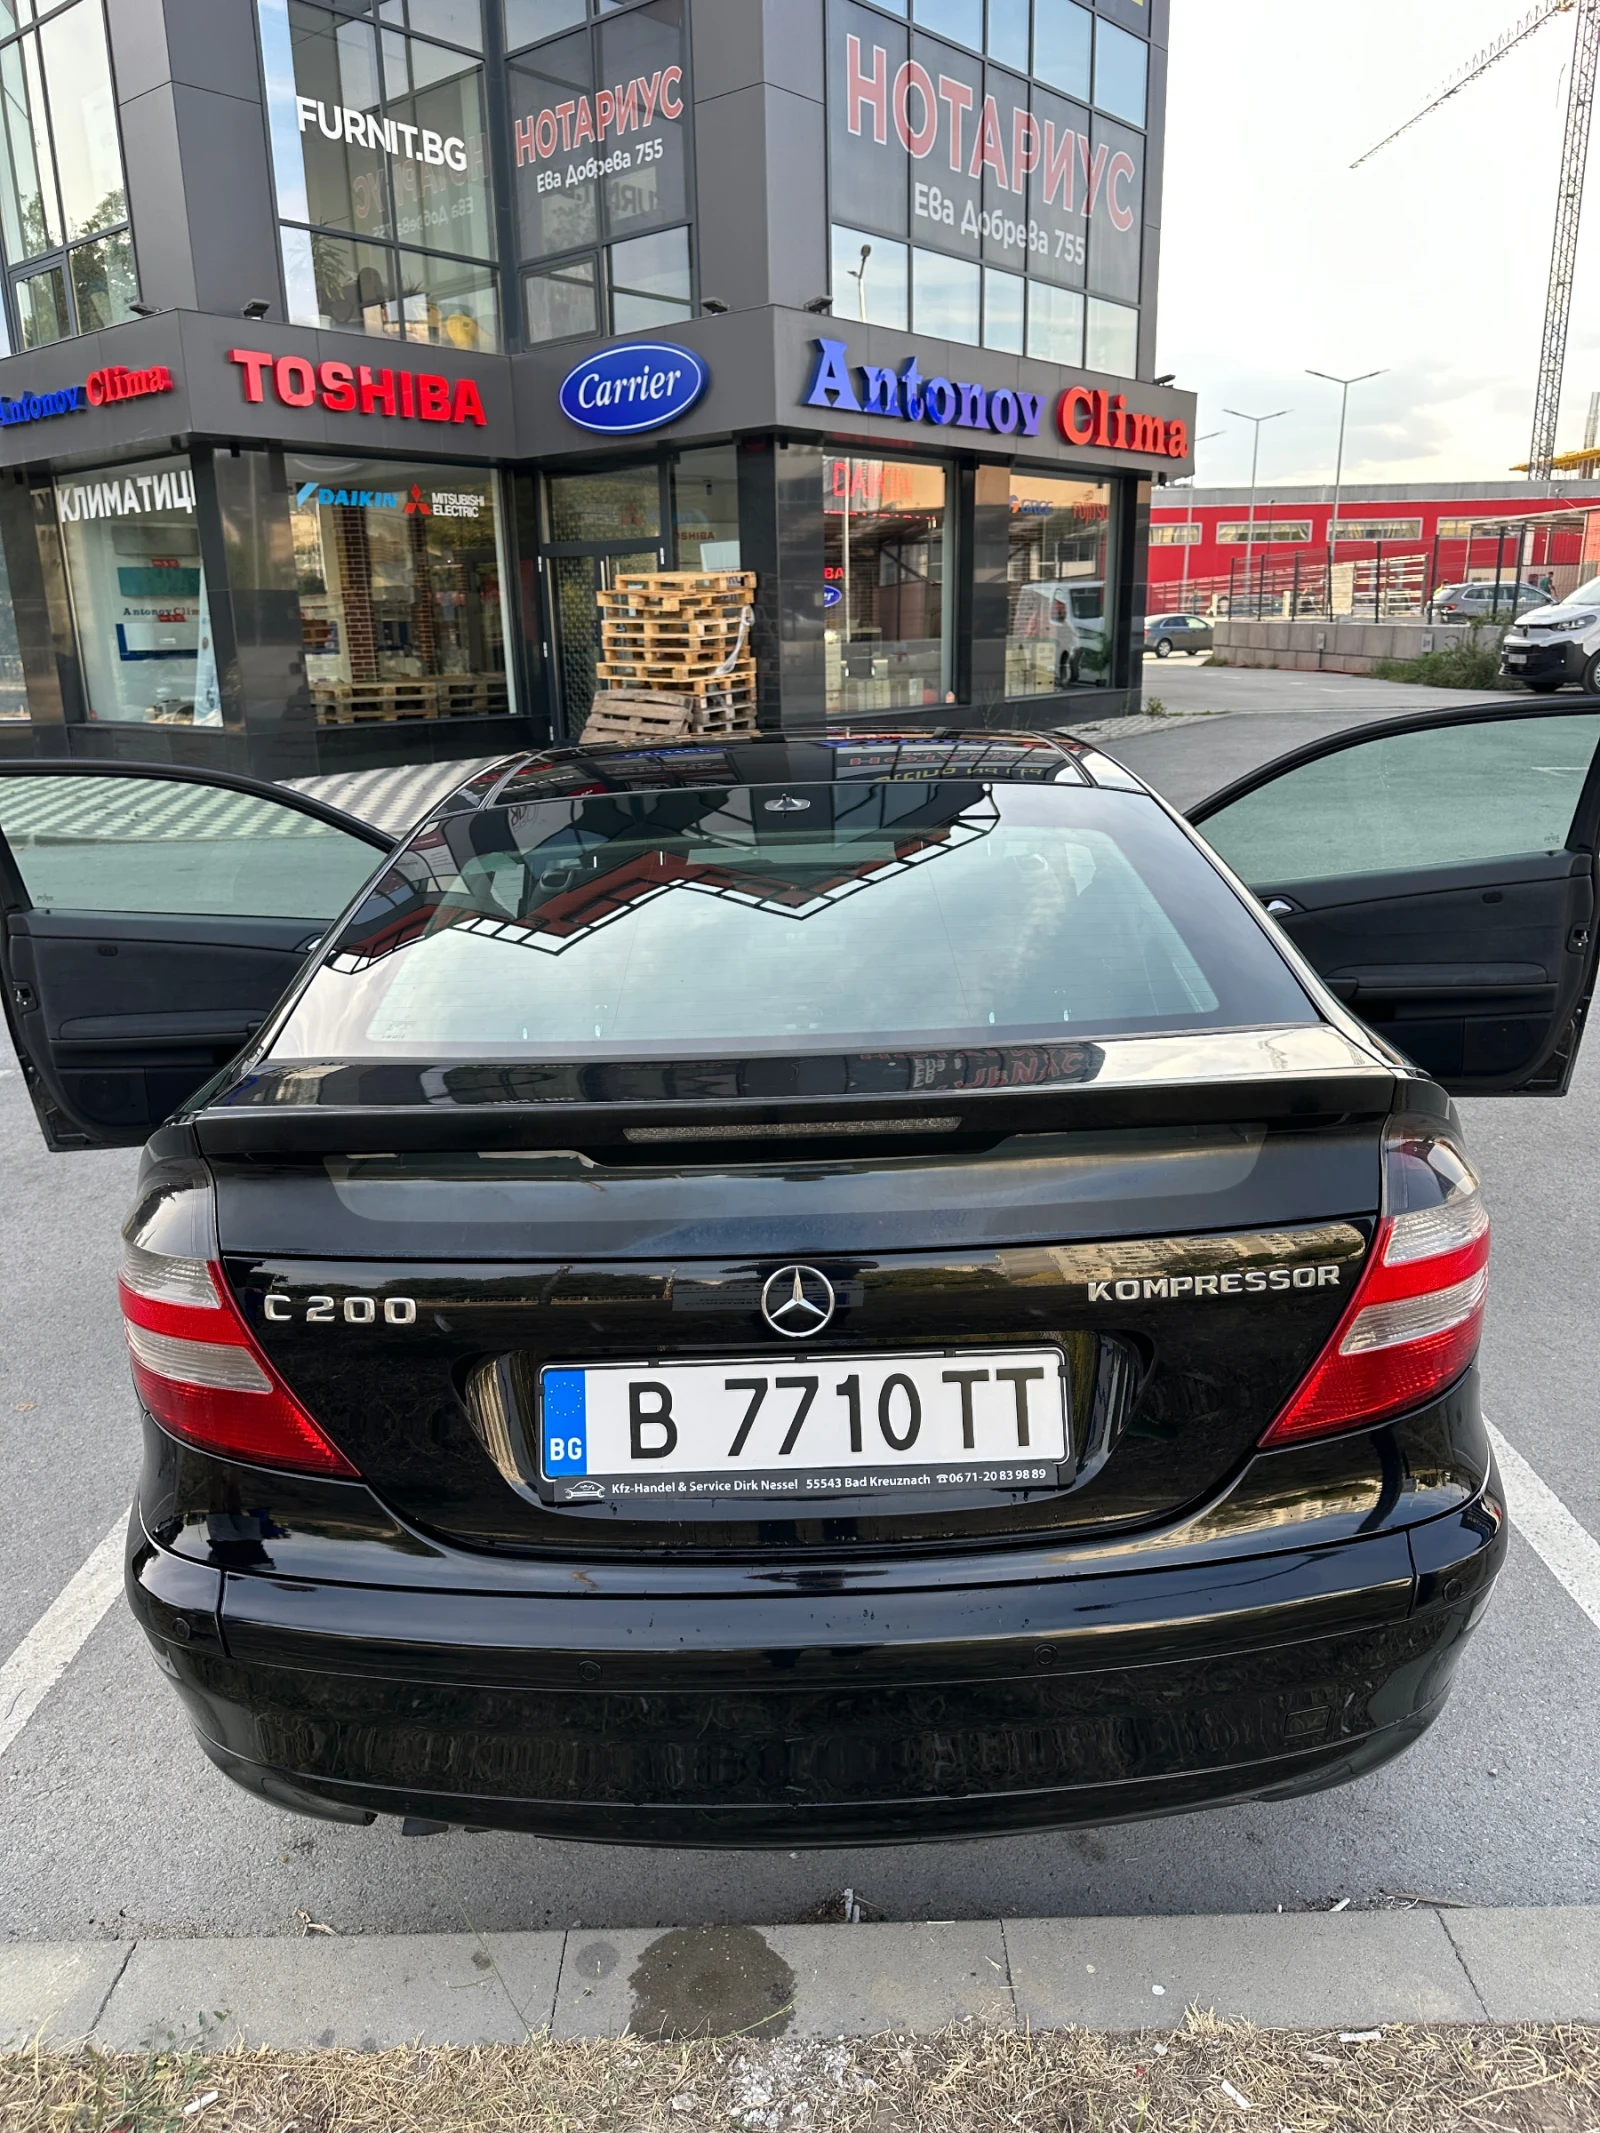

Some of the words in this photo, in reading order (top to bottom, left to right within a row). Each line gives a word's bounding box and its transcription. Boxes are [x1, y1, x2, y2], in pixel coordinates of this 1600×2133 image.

[296, 95, 468, 172] FURNIT.BG
[515, 65, 684, 168] НОТАРИУС
[847, 33, 1136, 232] НОТАРИУС
[536, 170, 562, 193] Ева
[565, 150, 632, 188] Добрева
[635, 138, 664, 165] 755
[914, 182, 955, 226] Ева
[960, 199, 1048, 256] Добрева
[1054, 229, 1086, 266] 755
[86, 365, 171, 406] Clima
[229, 348, 488, 427] TOSHIBA
[578, 365, 681, 409] Carrier
[803, 337, 1047, 437] Antonov
[1056, 385, 1189, 458] Clima
[318, 488, 398, 508] DAIKIN
[431, 492, 485, 507] MITSUBISHI
[832, 461, 913, 500] DAIKIN
[432, 504, 479, 518] ELECTRIC
[173, 607, 200, 617] Clim
[1088, 1265, 1340, 1302] KOMPRESSOR
[264, 1294, 292, 1321] C
[306, 1296, 417, 1324] 200
[629, 1381, 678, 1459] B
[725, 1373, 922, 1457] 7710
[942, 1367, 1044, 1448] TT
[550, 1437, 582, 1461] BG
[612, 1481, 675, 1494] Kfz-Handel
[678, 1483, 686, 1492] &
[690, 1481, 731, 1492] Service
[734, 1480, 758, 1490] Dirk
[761, 1478, 798, 1490] Nessel
[806, 1477, 842, 1489] 55543
[845, 1476, 867, 1488] Bad
[870, 1473, 931, 1487] Kreuznach
